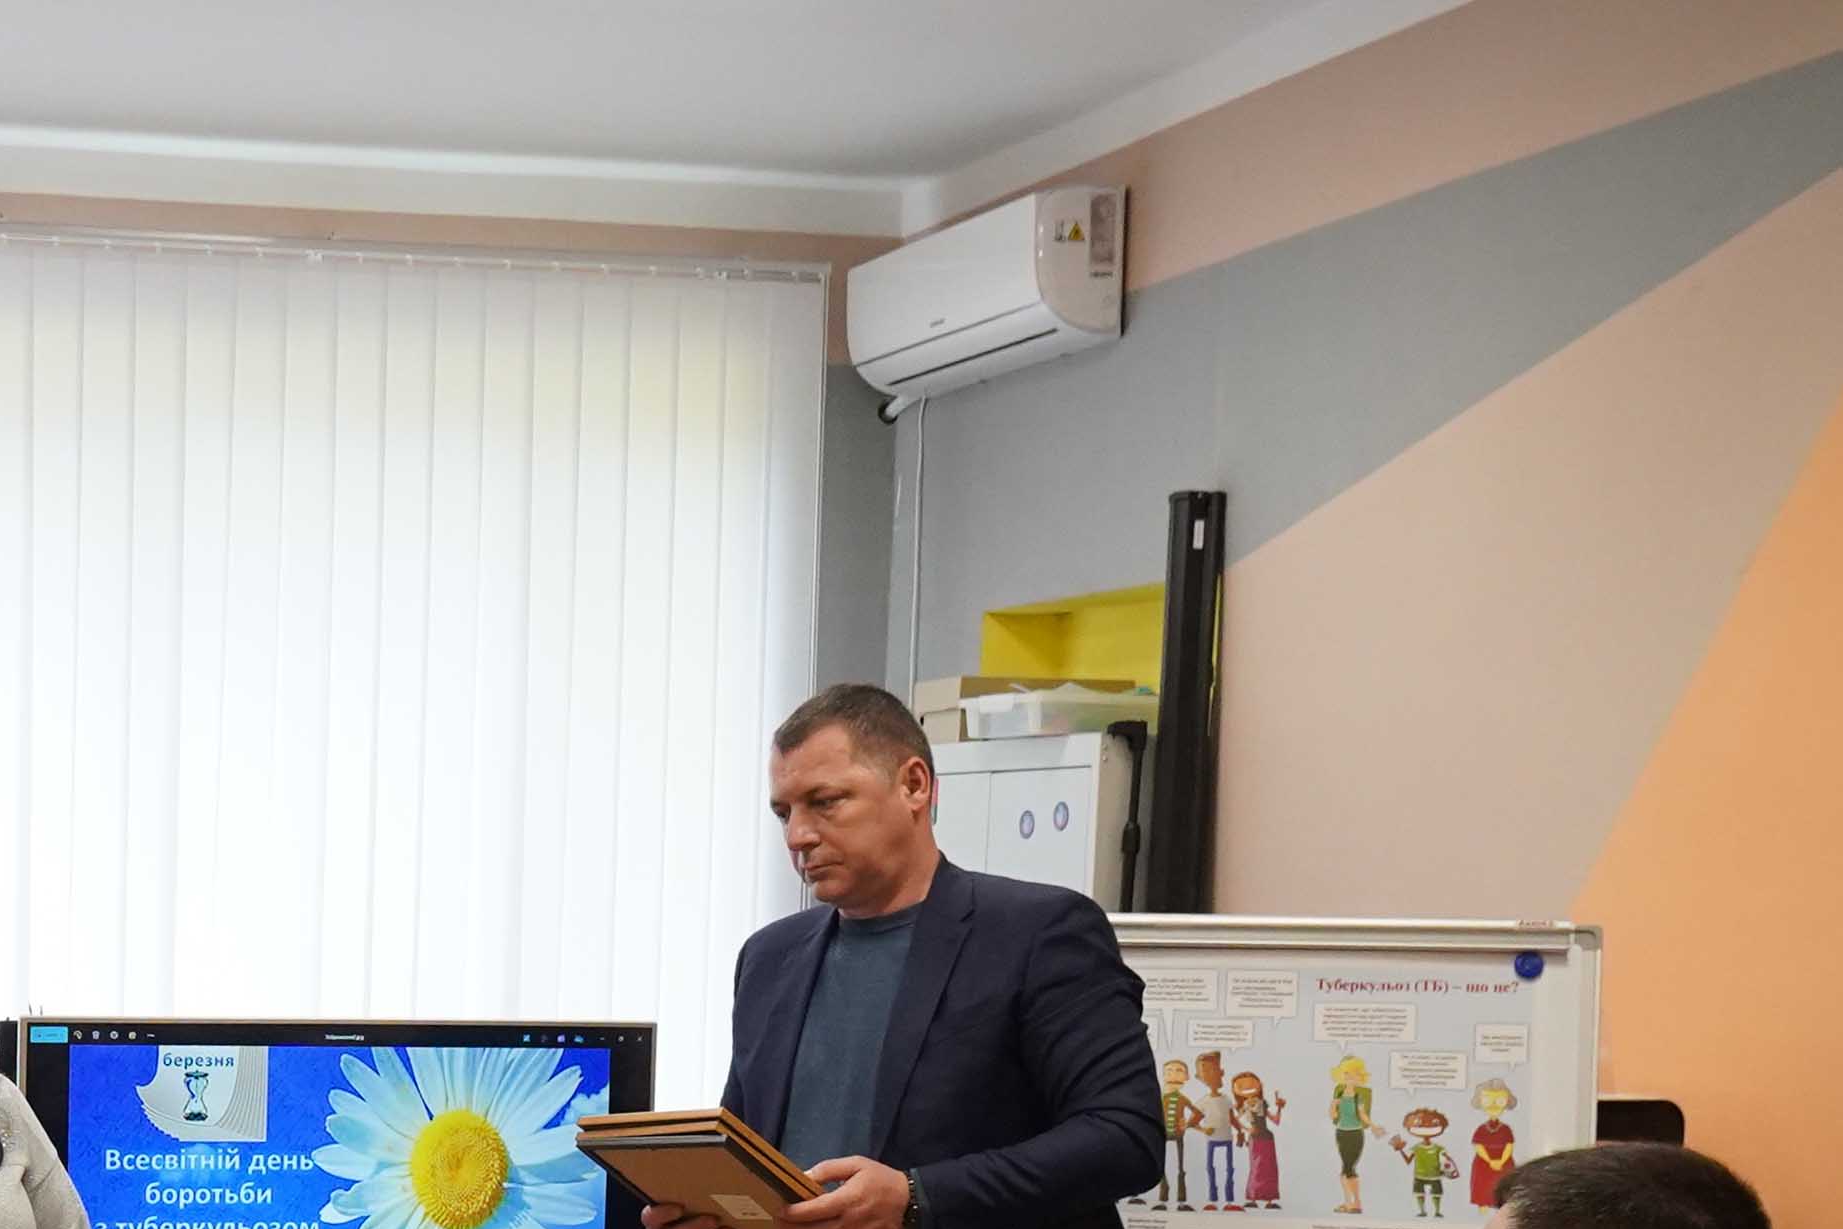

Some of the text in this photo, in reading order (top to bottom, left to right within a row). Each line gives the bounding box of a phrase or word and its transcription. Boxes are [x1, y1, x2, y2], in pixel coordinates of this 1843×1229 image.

[1315, 978, 1411, 995] Туберкульоз
[1414, 979, 1449, 994] (ТБ)
[1466, 983, 1488, 994] що
[1493, 982, 1519, 994] це?
[163, 1052, 234, 1070] березня
[106, 1148, 314, 1175] Всесвітній день
[145, 1182, 272, 1209] боротьби
